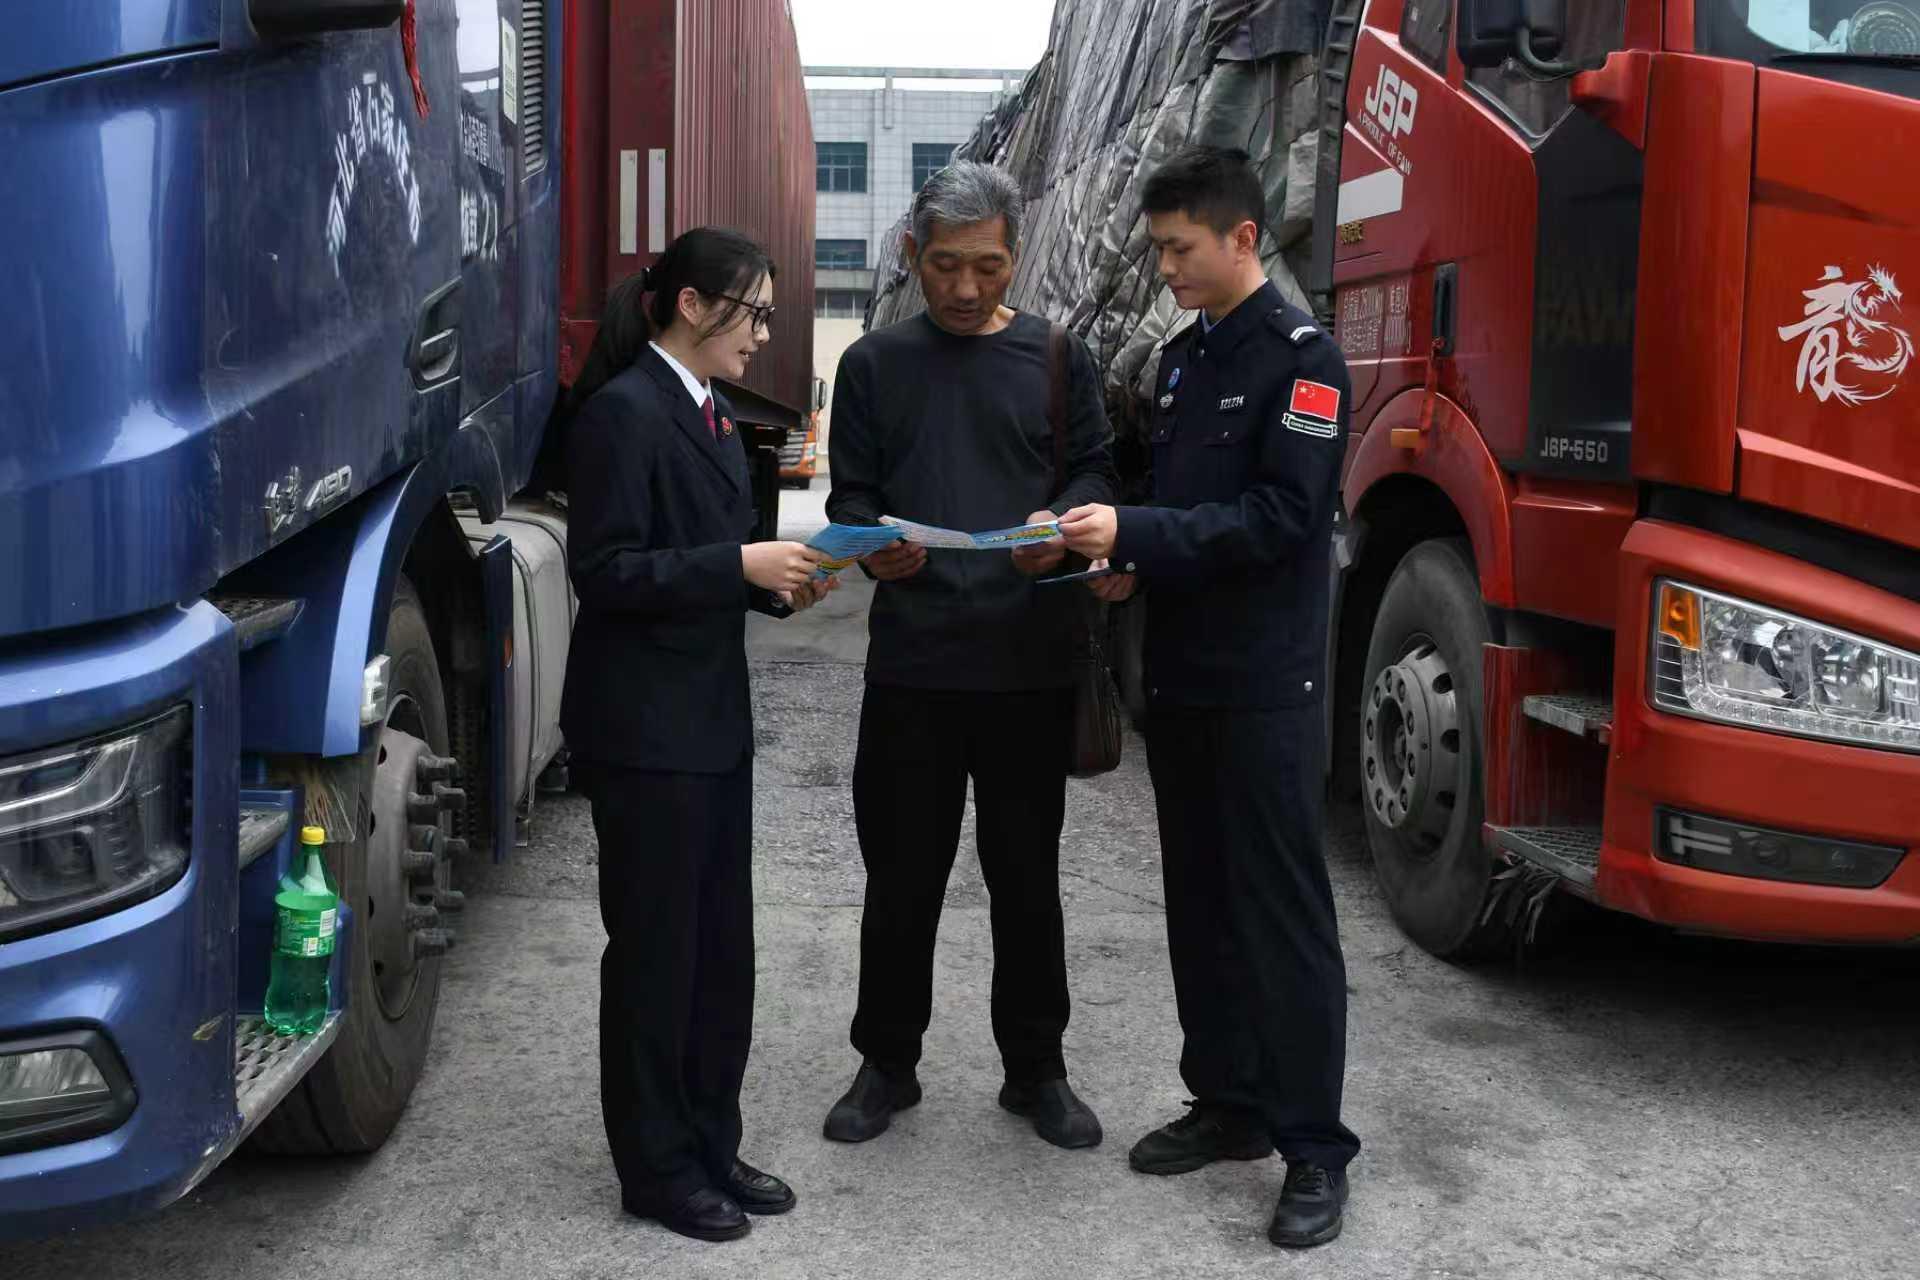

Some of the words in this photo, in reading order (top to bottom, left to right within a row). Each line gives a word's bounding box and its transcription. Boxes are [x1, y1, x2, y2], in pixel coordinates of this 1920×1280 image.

[1364, 64, 1418, 139] J6P
[326, 72, 422, 279] 河北省石家庄市
